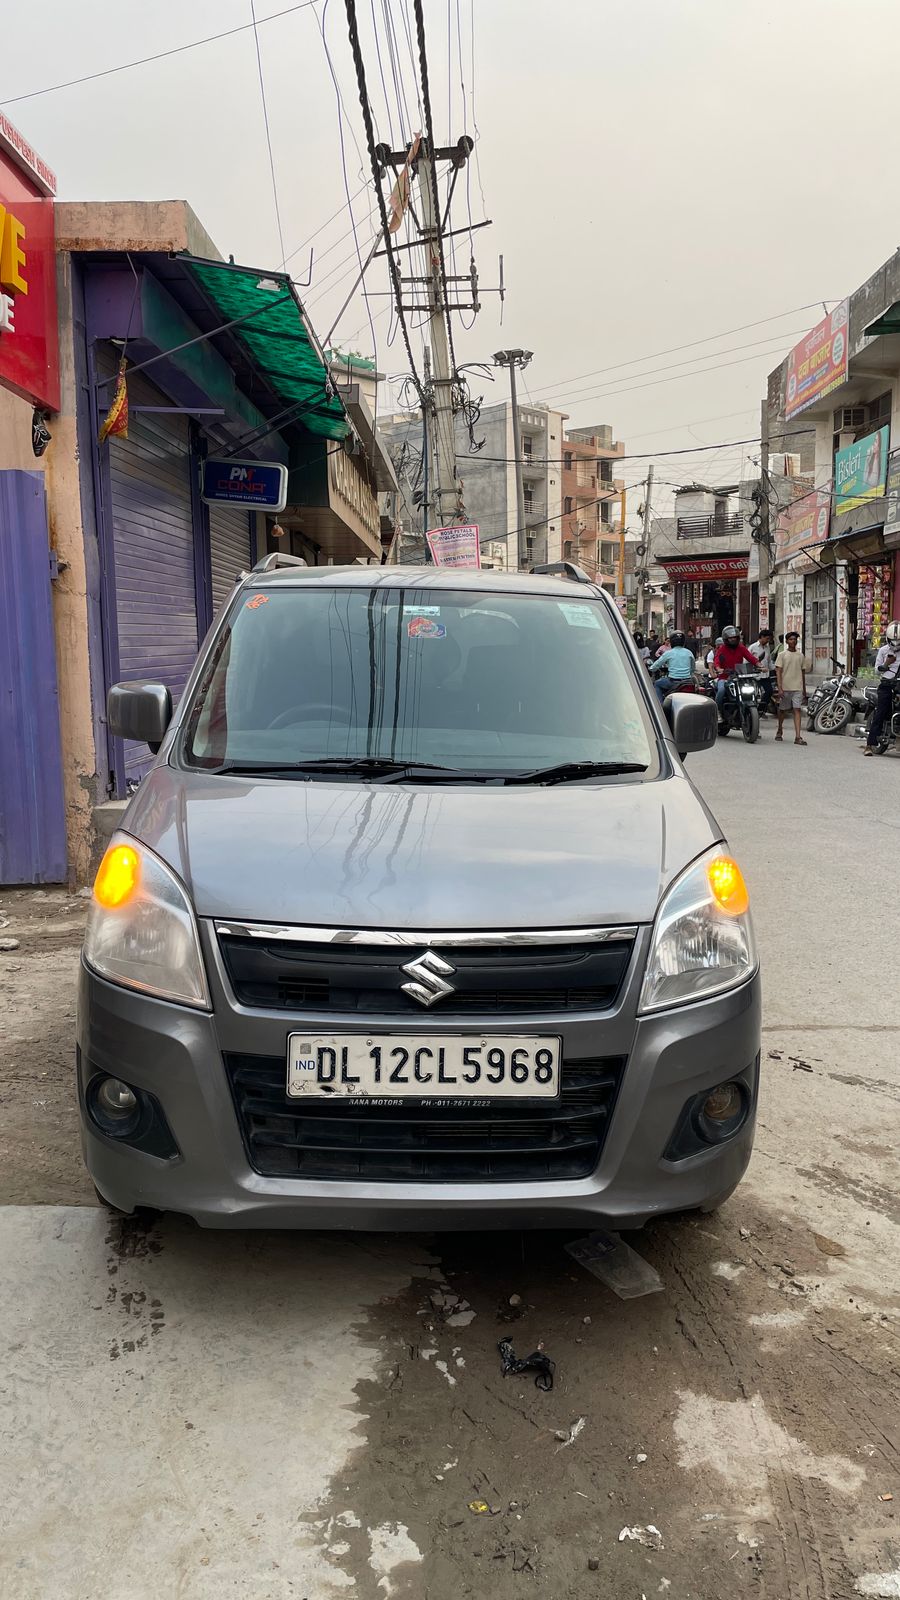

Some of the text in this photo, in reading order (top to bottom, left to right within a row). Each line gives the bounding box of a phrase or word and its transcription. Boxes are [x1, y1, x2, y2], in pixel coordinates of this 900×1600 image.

[0, 202, 28, 295] E
[838, 447, 861, 485] Bisleri
[666, 564, 698, 574] ASHISH
[701, 562, 728, 573] AUTO
[295, 1045, 554, 1084] IND DL12CL5968
